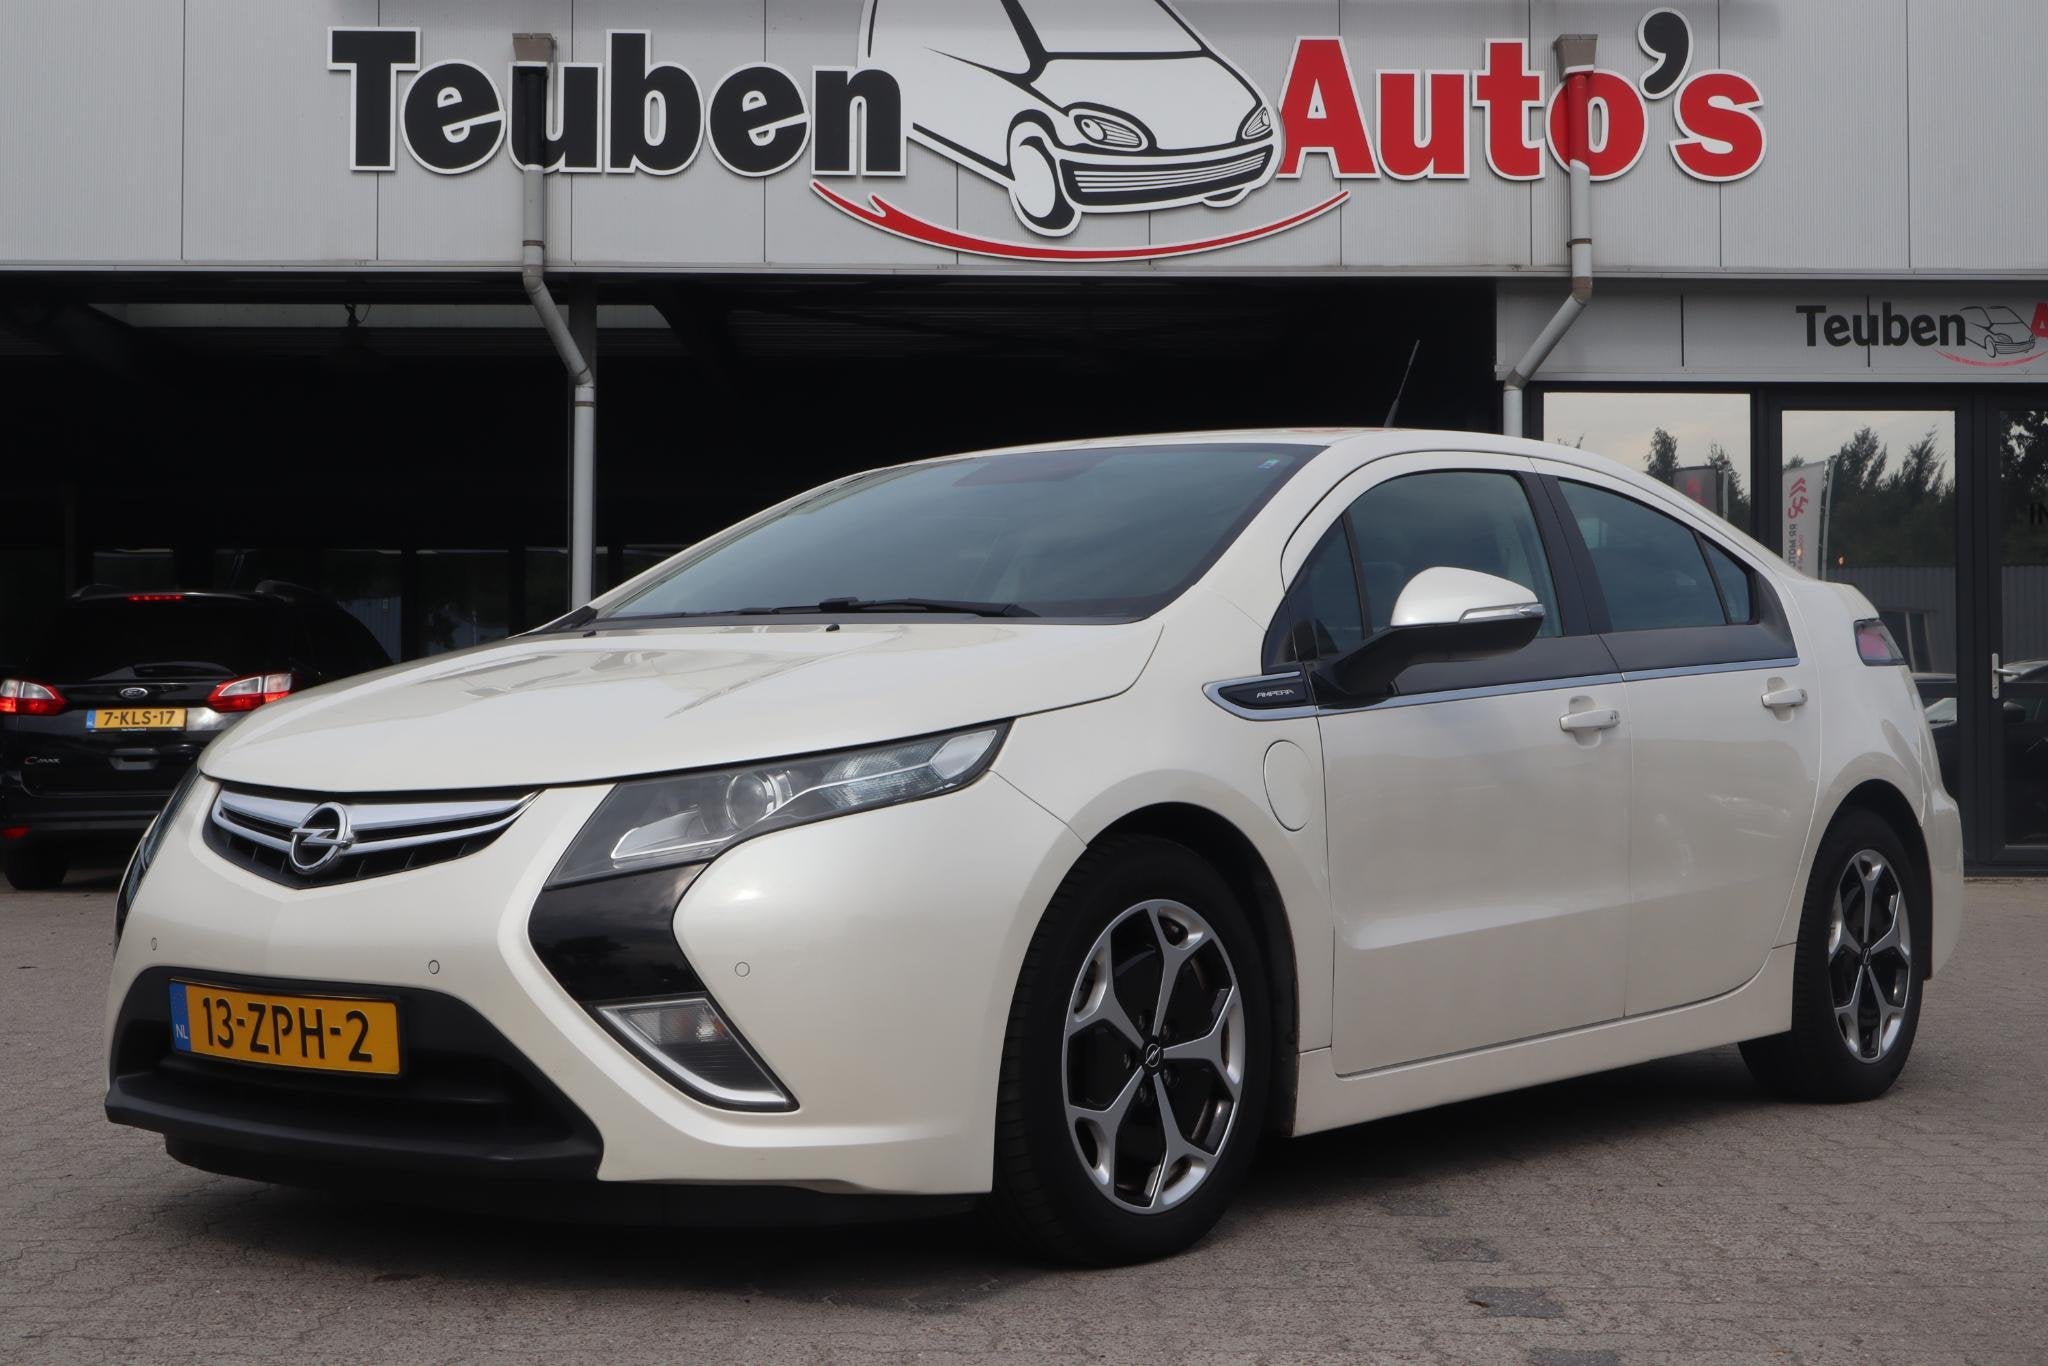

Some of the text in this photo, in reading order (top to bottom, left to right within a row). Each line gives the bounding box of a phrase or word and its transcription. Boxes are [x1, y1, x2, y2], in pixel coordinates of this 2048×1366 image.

[330, 9, 1765, 181] Teuben Auto's
[1796, 302, 1966, 347] Teuben
[104, 711, 176, 726] 7-KLS-17
[175, 1023, 189, 1040] NL
[203, 997, 373, 1063] 13-ZPH-2
